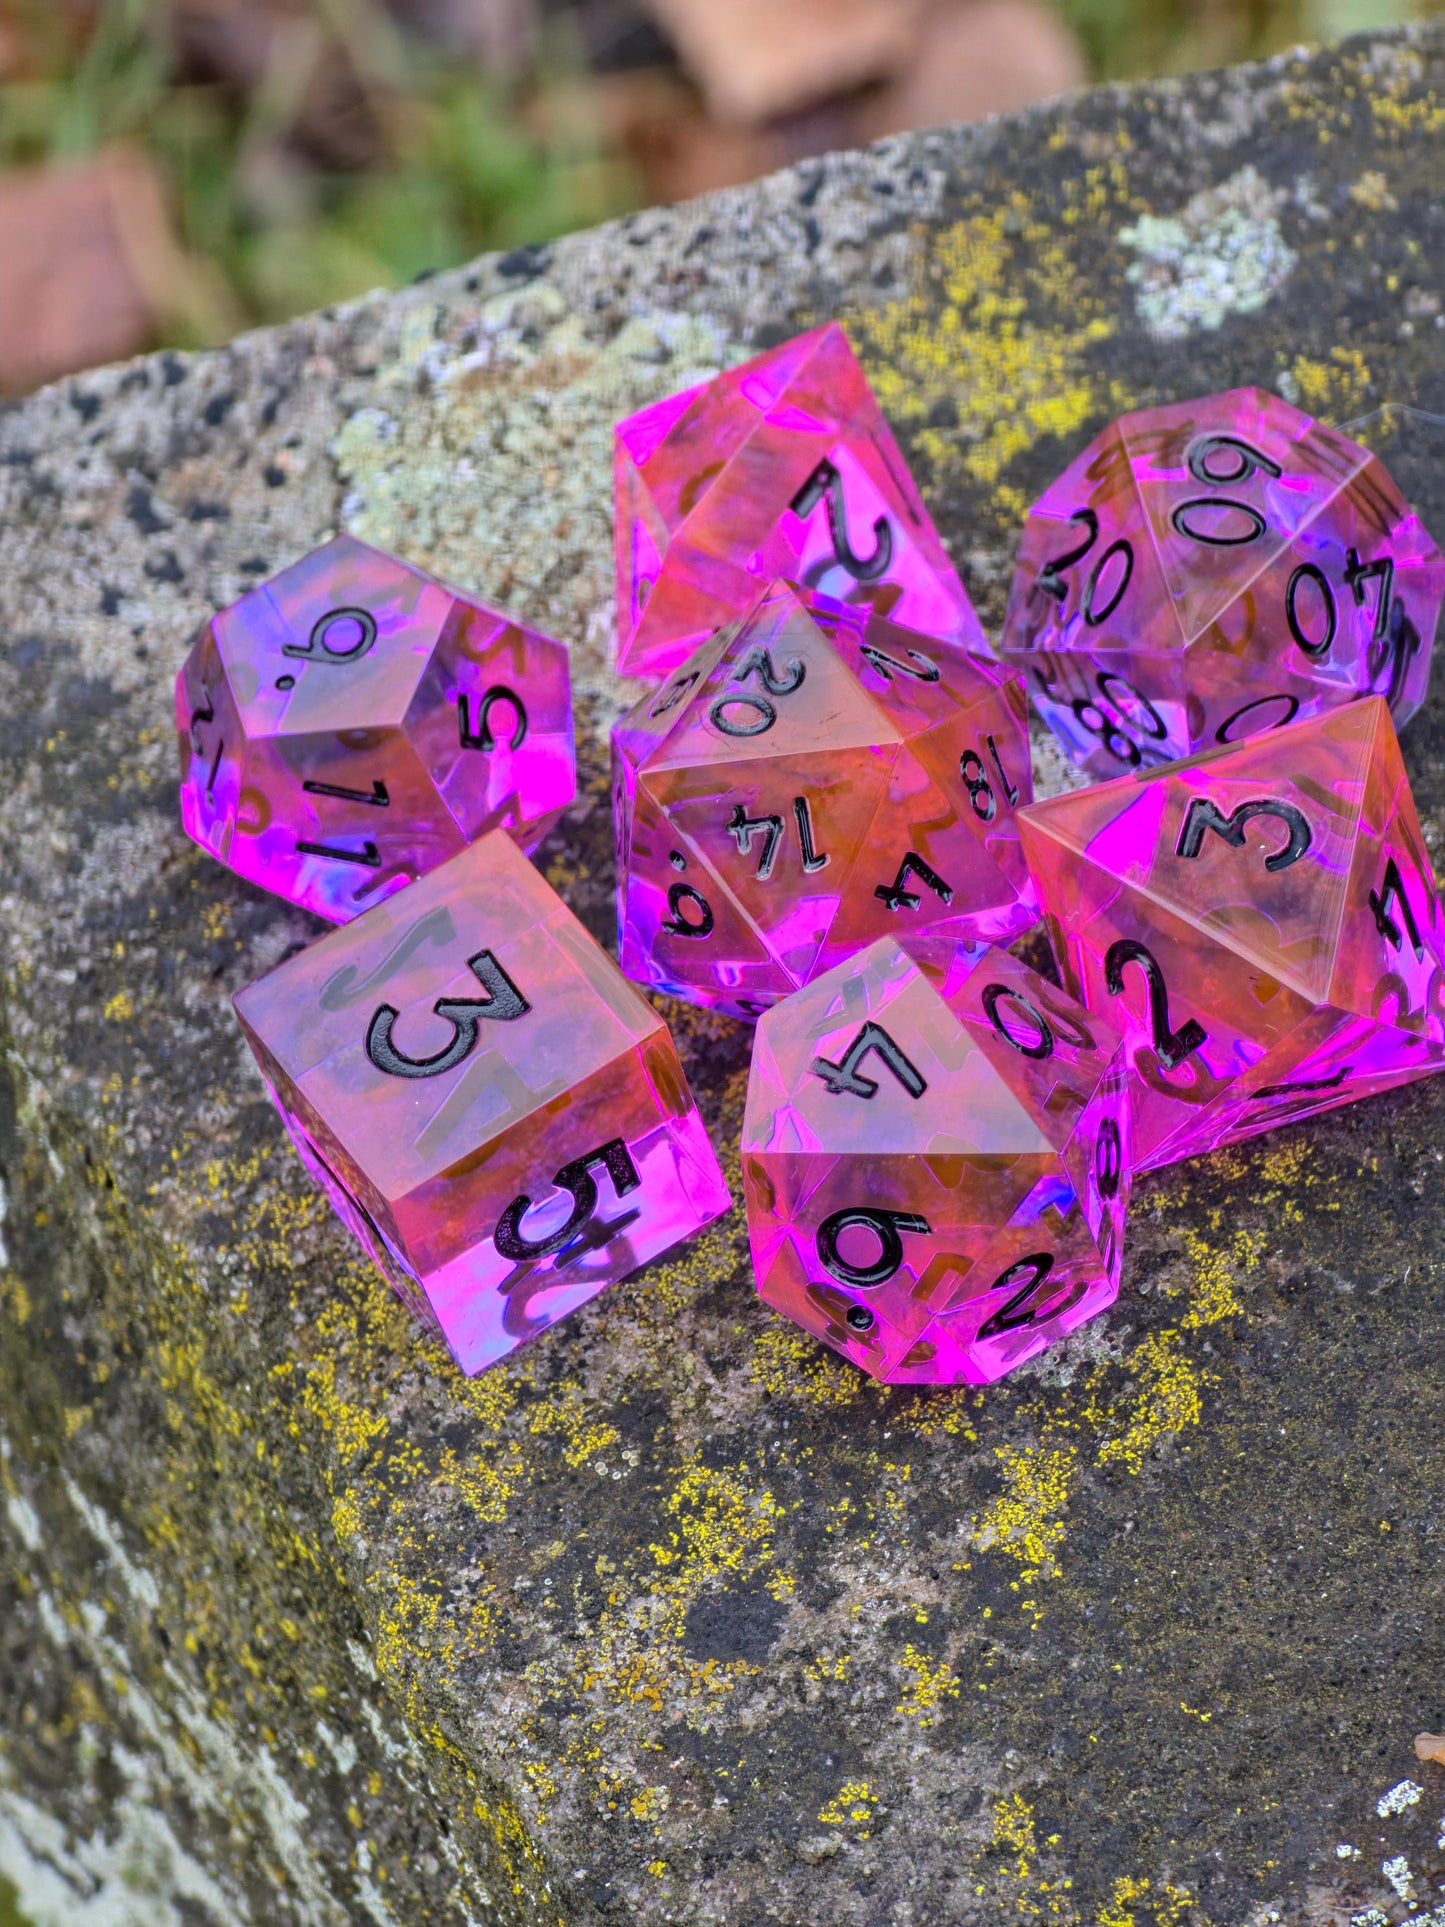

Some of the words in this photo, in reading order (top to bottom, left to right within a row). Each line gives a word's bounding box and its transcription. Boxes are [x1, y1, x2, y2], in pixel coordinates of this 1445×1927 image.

[1037, 509, 1133, 626] 20
[1285, 547, 1394, 655] 40
[708, 644, 806, 737] 20
[858, 643, 941, 683] 2
[457, 686, 527, 753] 5
[1072, 672, 1167, 767] 80
[1216, 694, 1299, 744] 0
[959, 735, 1020, 822] 18
[295, 780, 390, 868] 11
[725, 796, 831, 881] 14
[1174, 795, 1312, 874] 3
[874, 851, 955, 912] 4
[1368, 857, 1424, 965] 4
[363, 948, 531, 1078] 3
[982, 983, 1054, 1060] 0
[1104, 938, 1207, 1069] 2
[493, 1137, 642, 1262] 5
[976, 1252, 1055, 1342] 2
